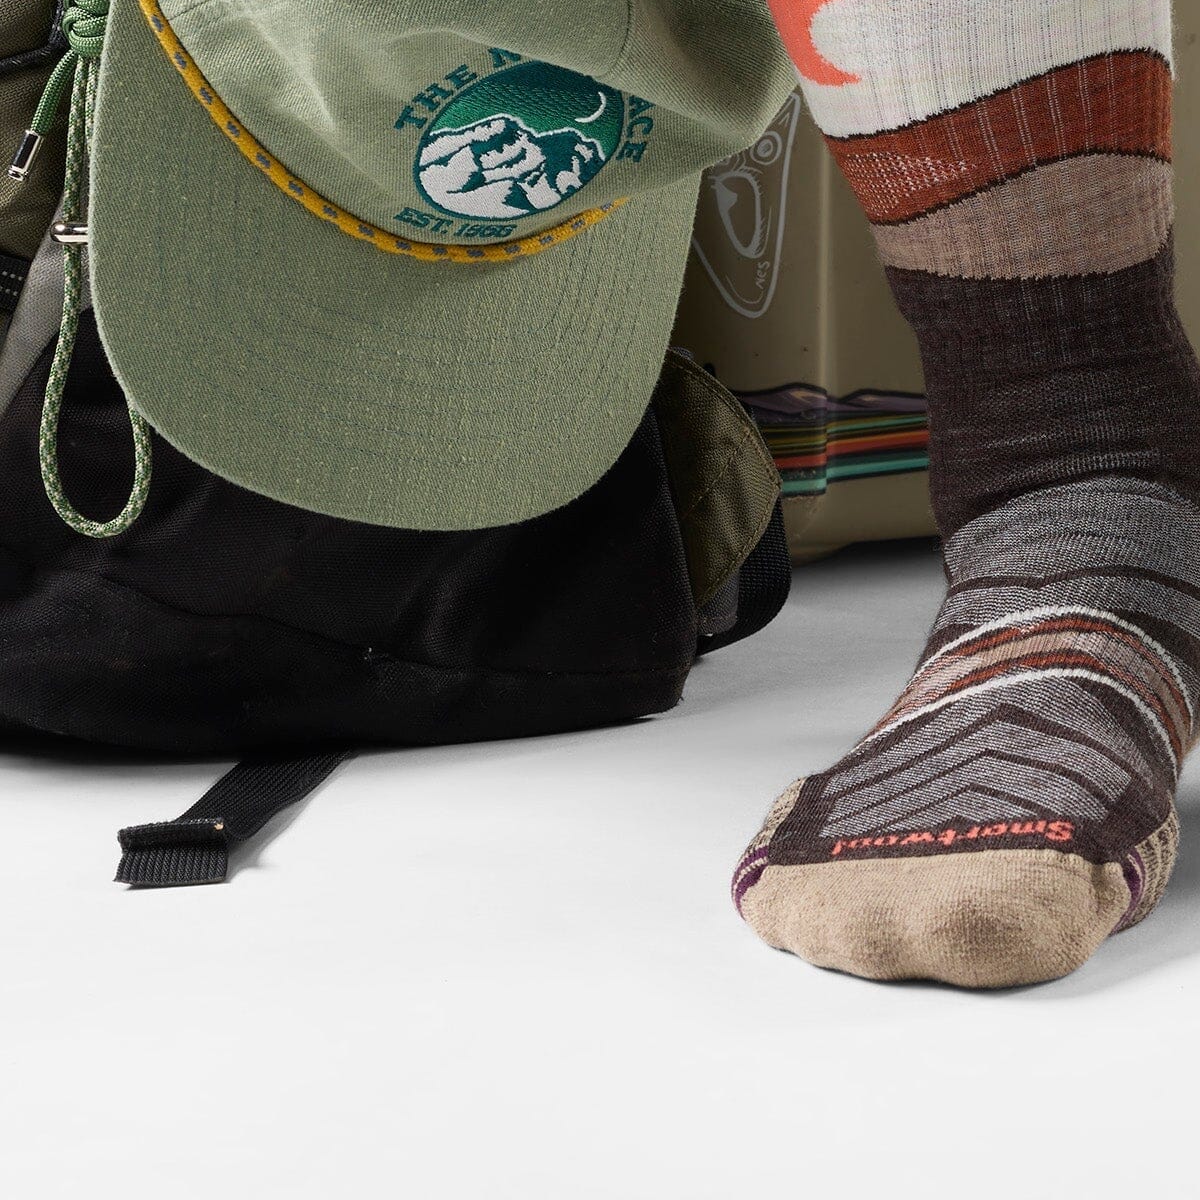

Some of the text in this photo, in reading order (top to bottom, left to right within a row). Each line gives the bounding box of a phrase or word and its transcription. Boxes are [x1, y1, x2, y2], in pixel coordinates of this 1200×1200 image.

[394, 64, 477, 130] THE
[393, 206, 454, 235] EST.
[831, 819, 1074, 856] Smartwool
